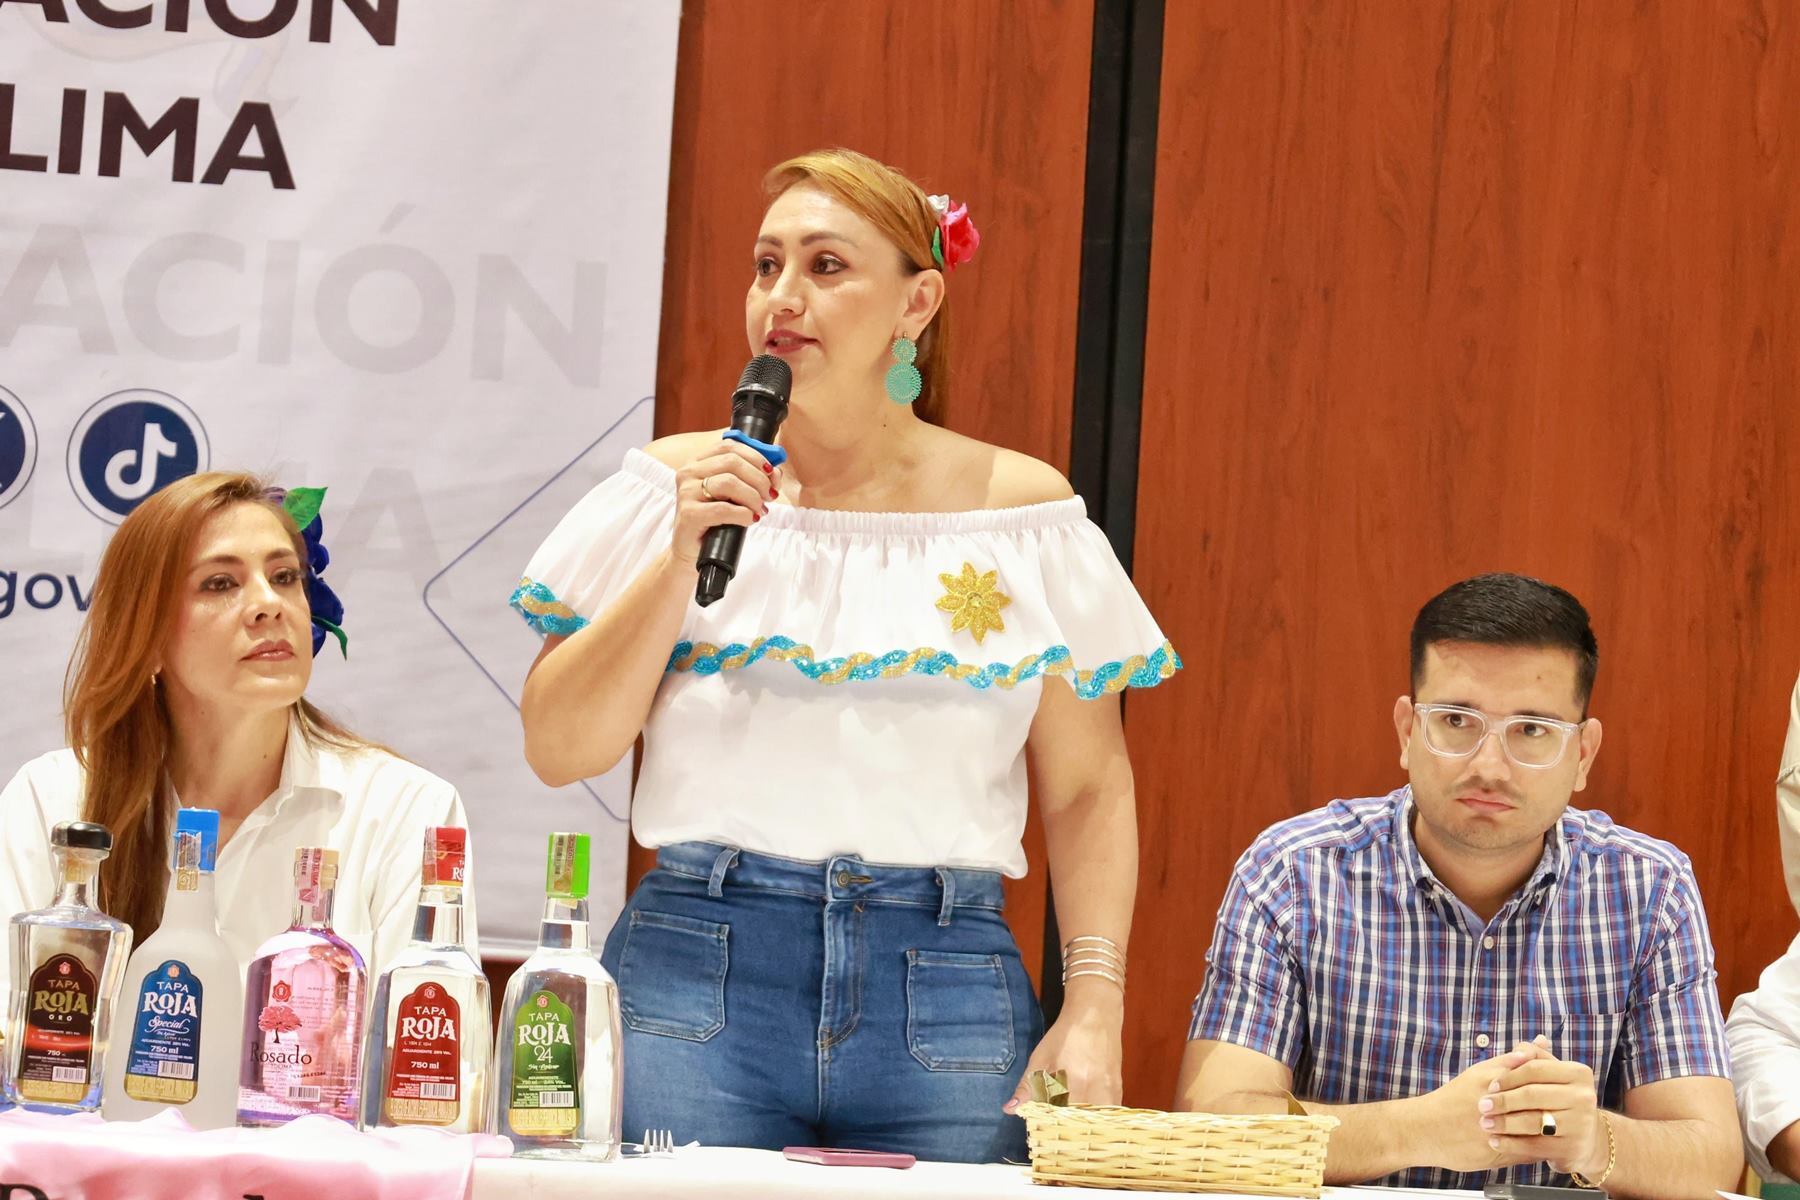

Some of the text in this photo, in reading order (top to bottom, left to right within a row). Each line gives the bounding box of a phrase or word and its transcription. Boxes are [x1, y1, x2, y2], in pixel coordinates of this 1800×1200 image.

[48, 979, 80, 990] TAPA
[156, 981, 189, 993] TAPA
[33, 990, 88, 1015] ROJA
[142, 991, 197, 1018] ROJA
[414, 1006, 447, 1016] TAPA
[144, 1015, 191, 1035] Special
[529, 1012, 560, 1022] TAPA
[401, 1016, 456, 1041] ROJA
[518, 1022, 571, 1046] ROJA
[150, 1045, 168, 1053] 750
[250, 1042, 312, 1065] Rosado
[534, 1045, 553, 1063] 24
[411, 1061, 428, 1069] 750
